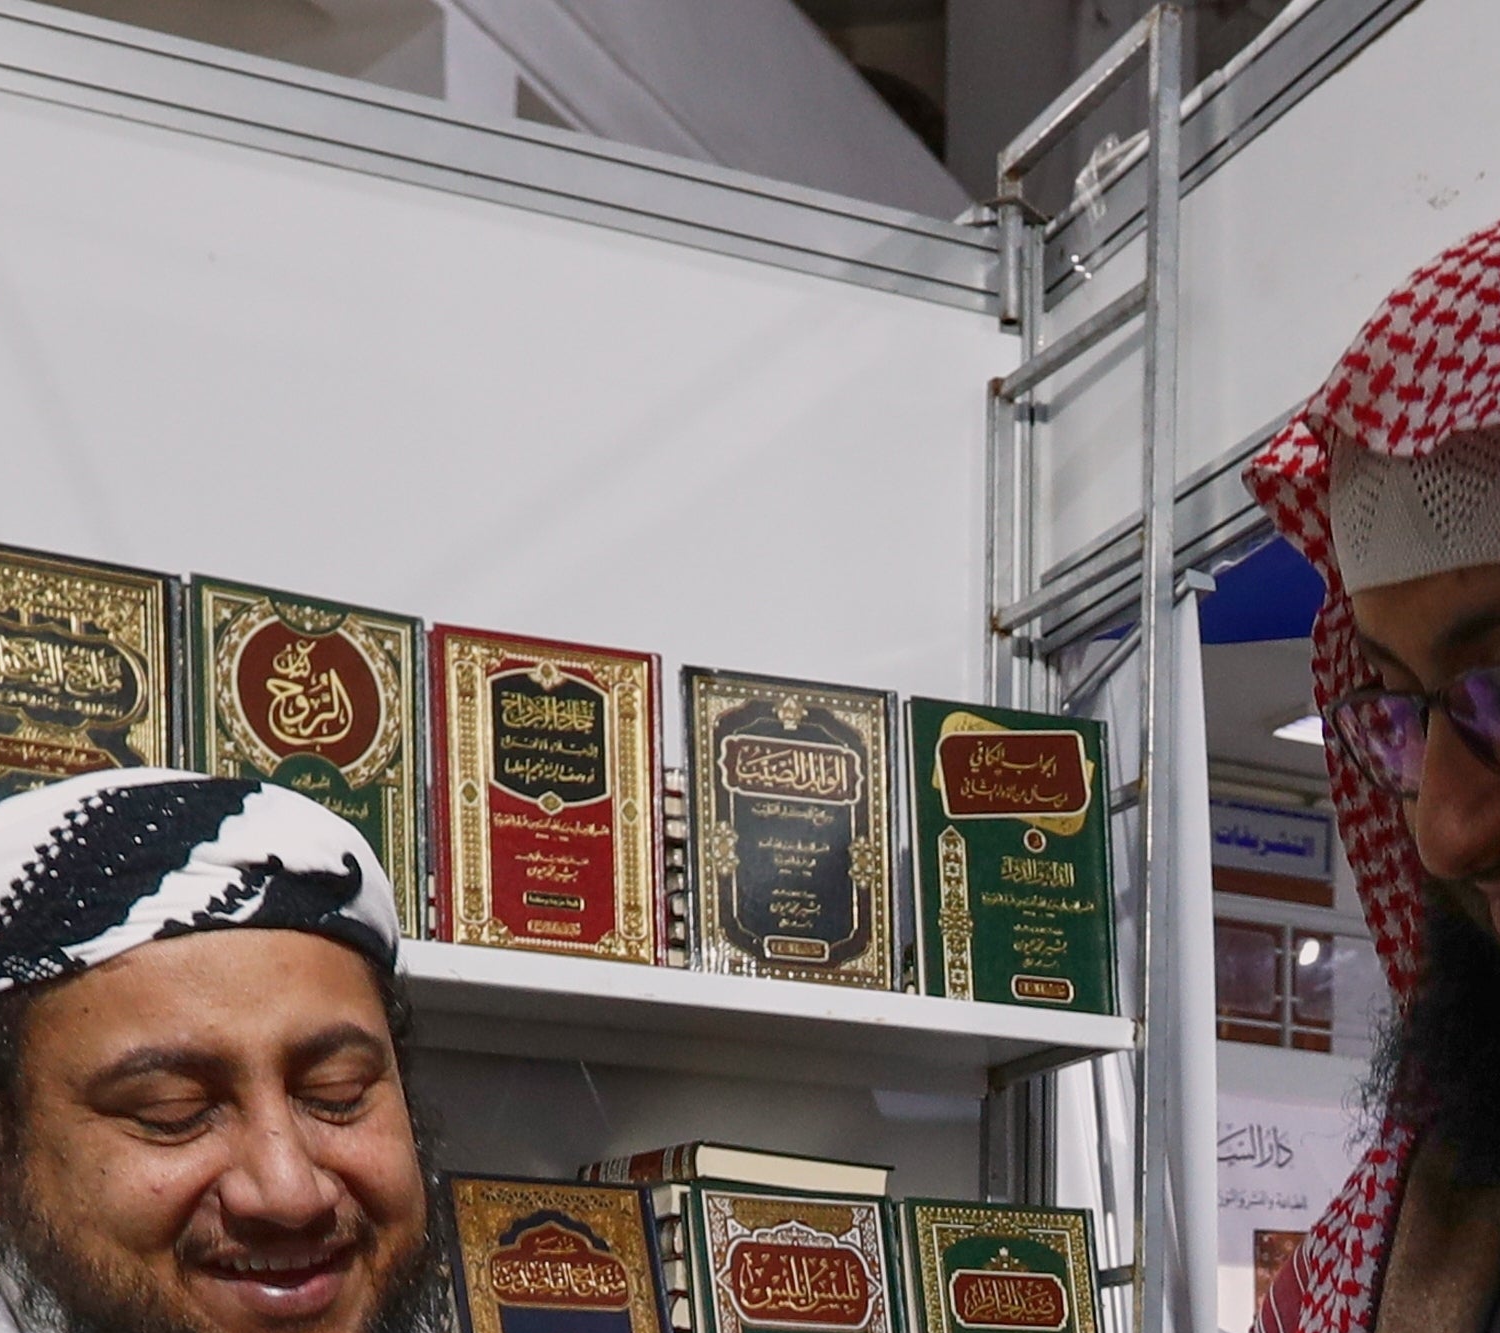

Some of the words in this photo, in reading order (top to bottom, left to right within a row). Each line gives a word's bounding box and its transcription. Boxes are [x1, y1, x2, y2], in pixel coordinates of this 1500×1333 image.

[266, 668, 353, 746] الروح
[740, 1254, 811, 1311] إبليس
[790, 1260, 861, 1313] تلبيس
[964, 1278, 1022, 1319] الخاطر
